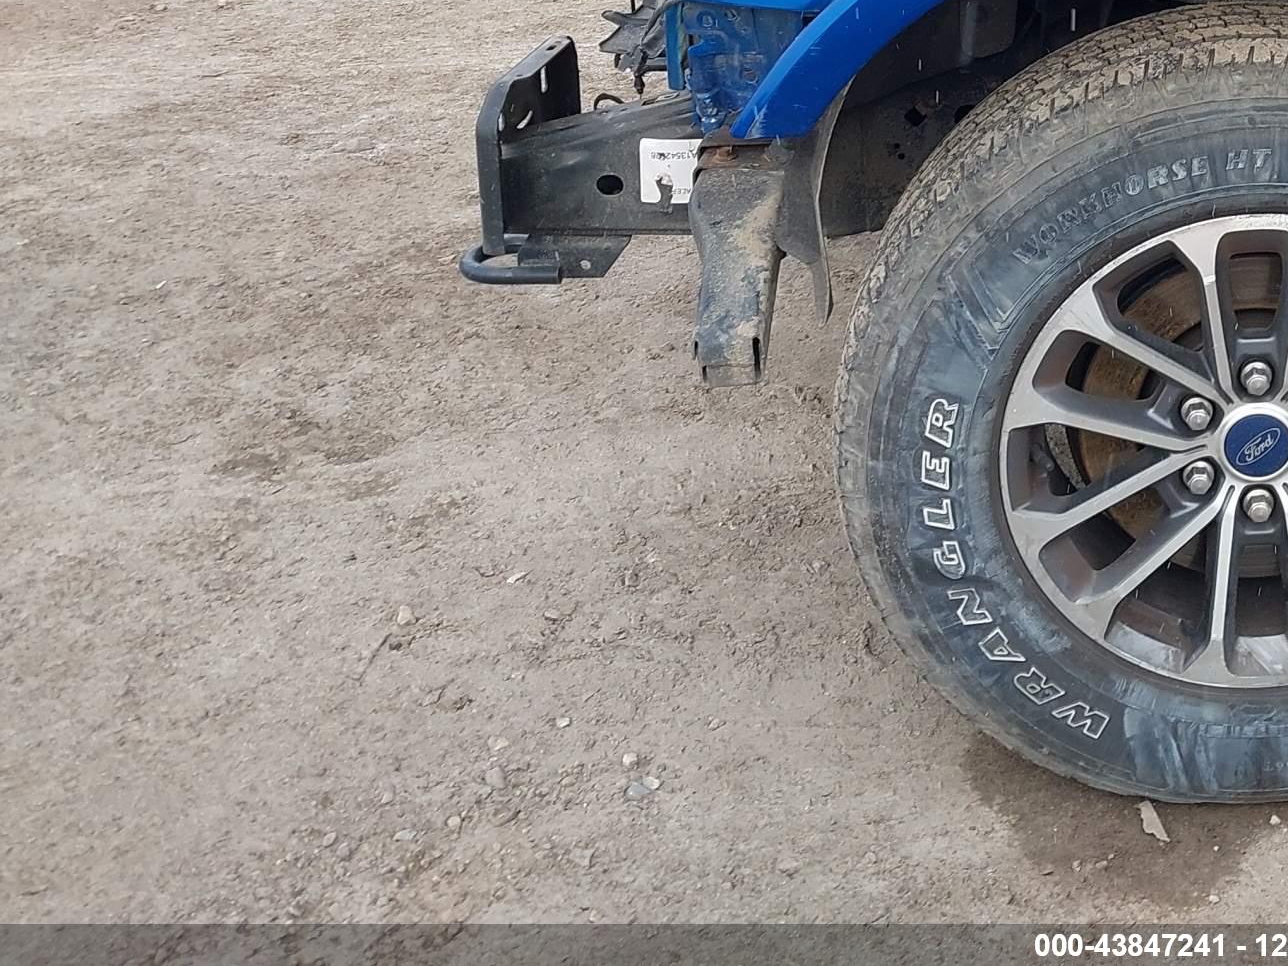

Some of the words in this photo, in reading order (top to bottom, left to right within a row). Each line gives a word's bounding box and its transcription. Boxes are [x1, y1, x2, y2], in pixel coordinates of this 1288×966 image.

[1012, 155, 1209, 265] WORKHORSE
[1225, 148, 1272, 171] HT
[1244, 432, 1275, 462] Ford
[921, 398, 1110, 739] WRANGLER
